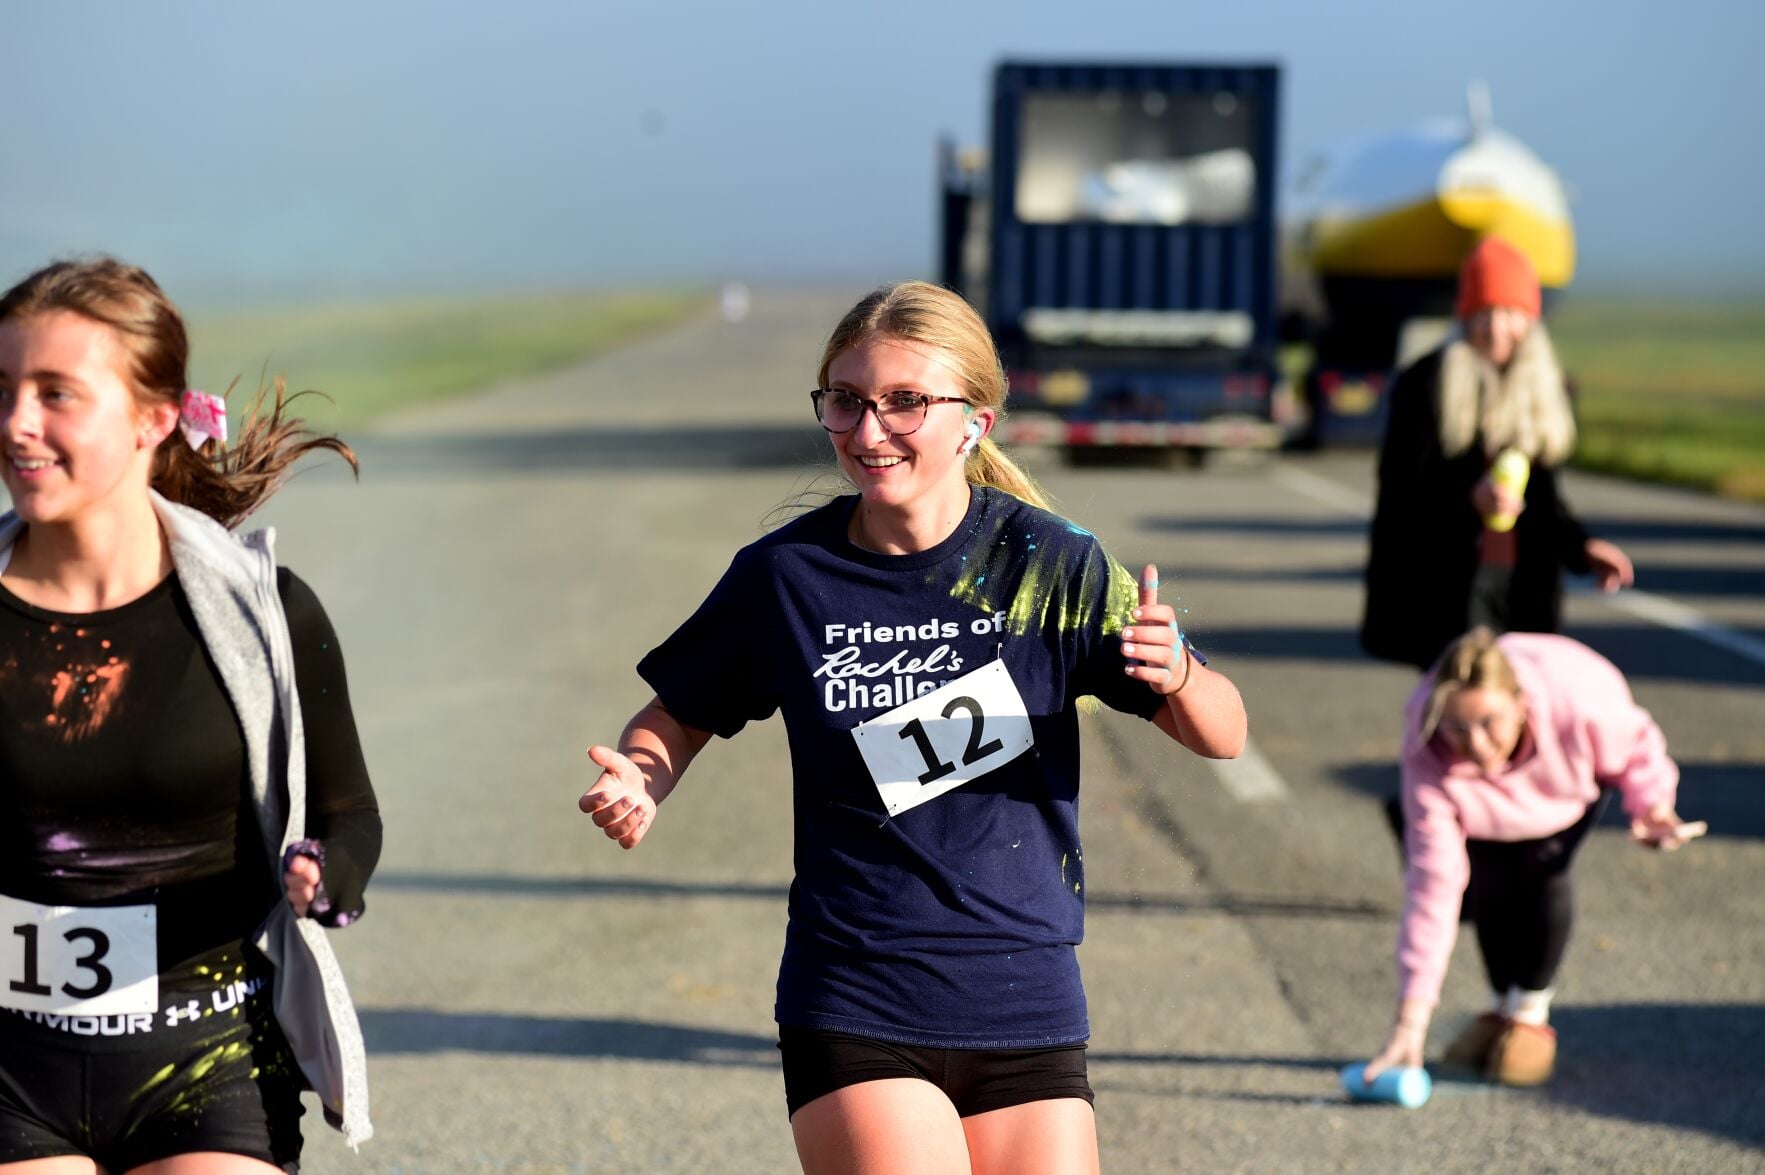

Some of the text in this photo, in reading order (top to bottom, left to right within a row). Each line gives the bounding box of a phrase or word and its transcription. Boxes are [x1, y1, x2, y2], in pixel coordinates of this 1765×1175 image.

[825, 610, 1007, 644] Friends of
[813, 644, 964, 679] Rachel's
[824, 675, 955, 712] Challe
[898, 695, 1004, 786] 12
[9, 923, 113, 1000] 13
